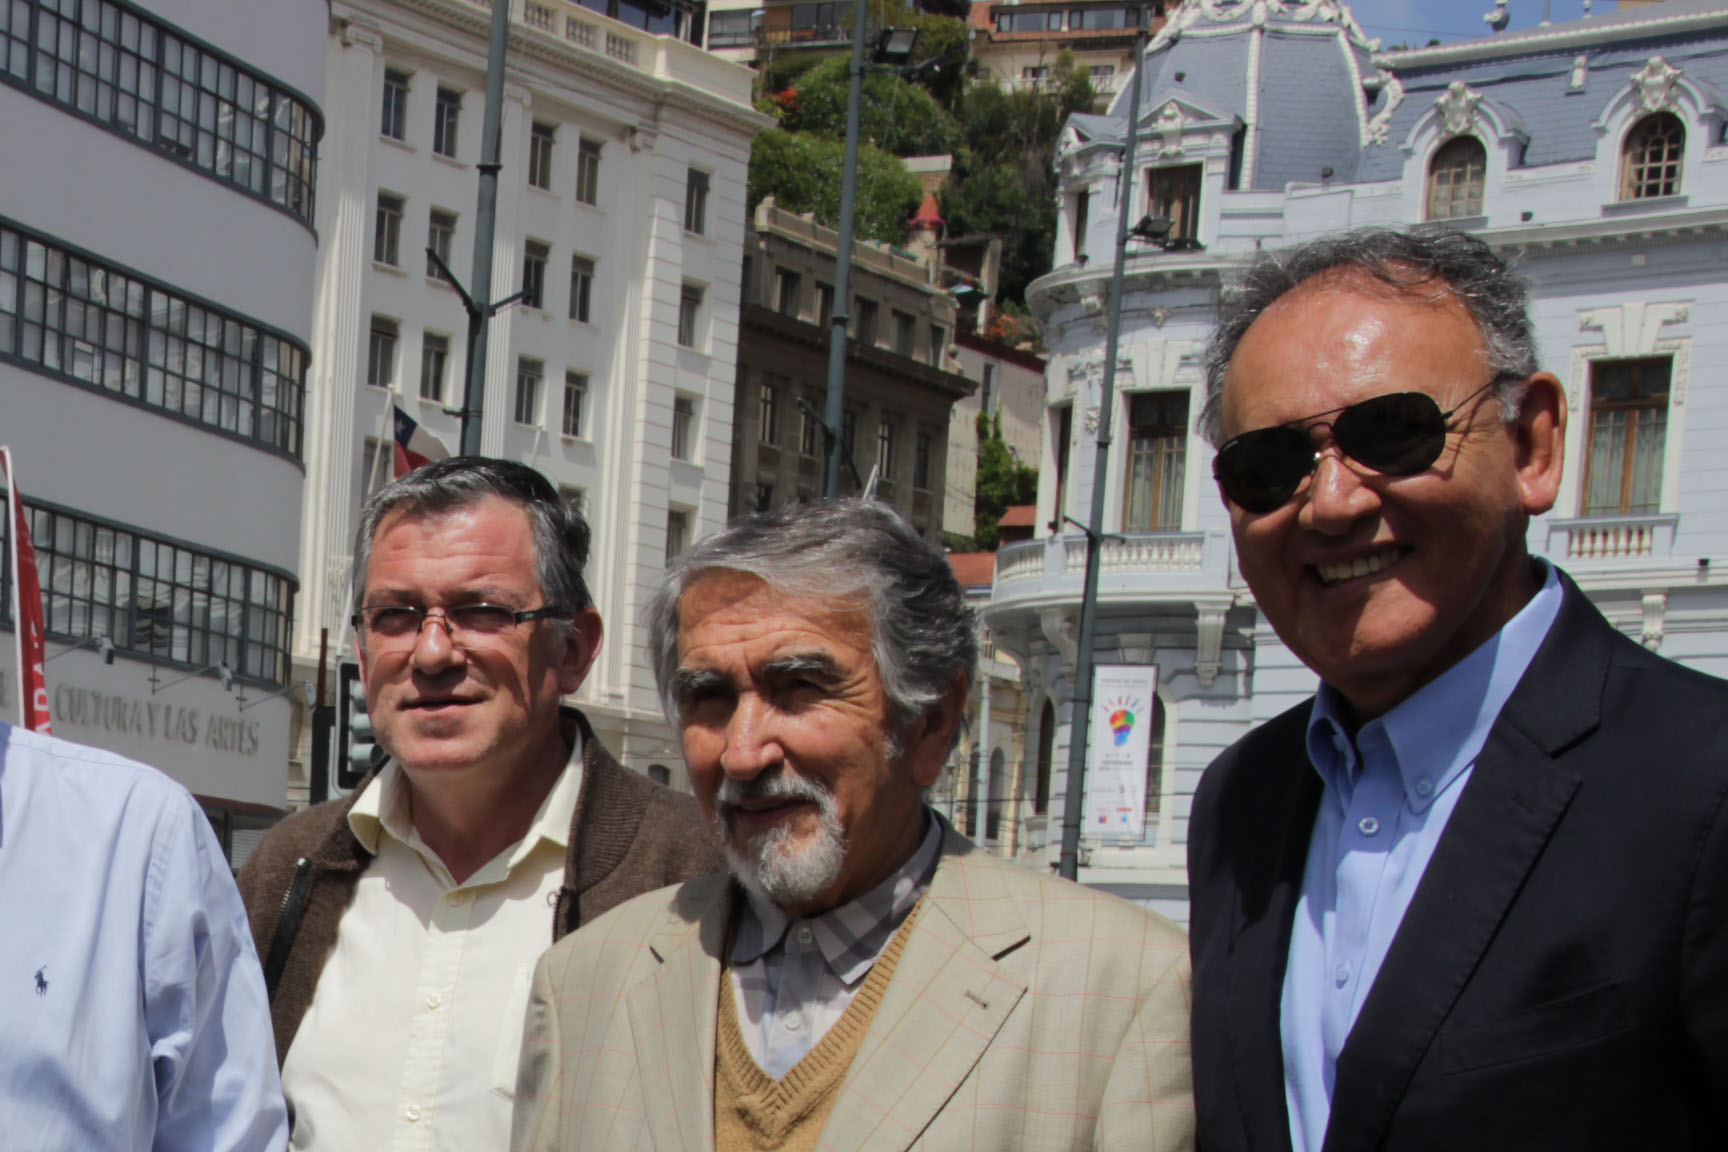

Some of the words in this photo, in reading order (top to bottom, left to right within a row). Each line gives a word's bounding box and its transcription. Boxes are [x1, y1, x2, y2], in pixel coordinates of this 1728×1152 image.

[55, 682, 144, 736] CULTURA
[146, 700, 161, 739] Y
[164, 703, 199, 745] LAS
[204, 713, 260, 758] ARTES
